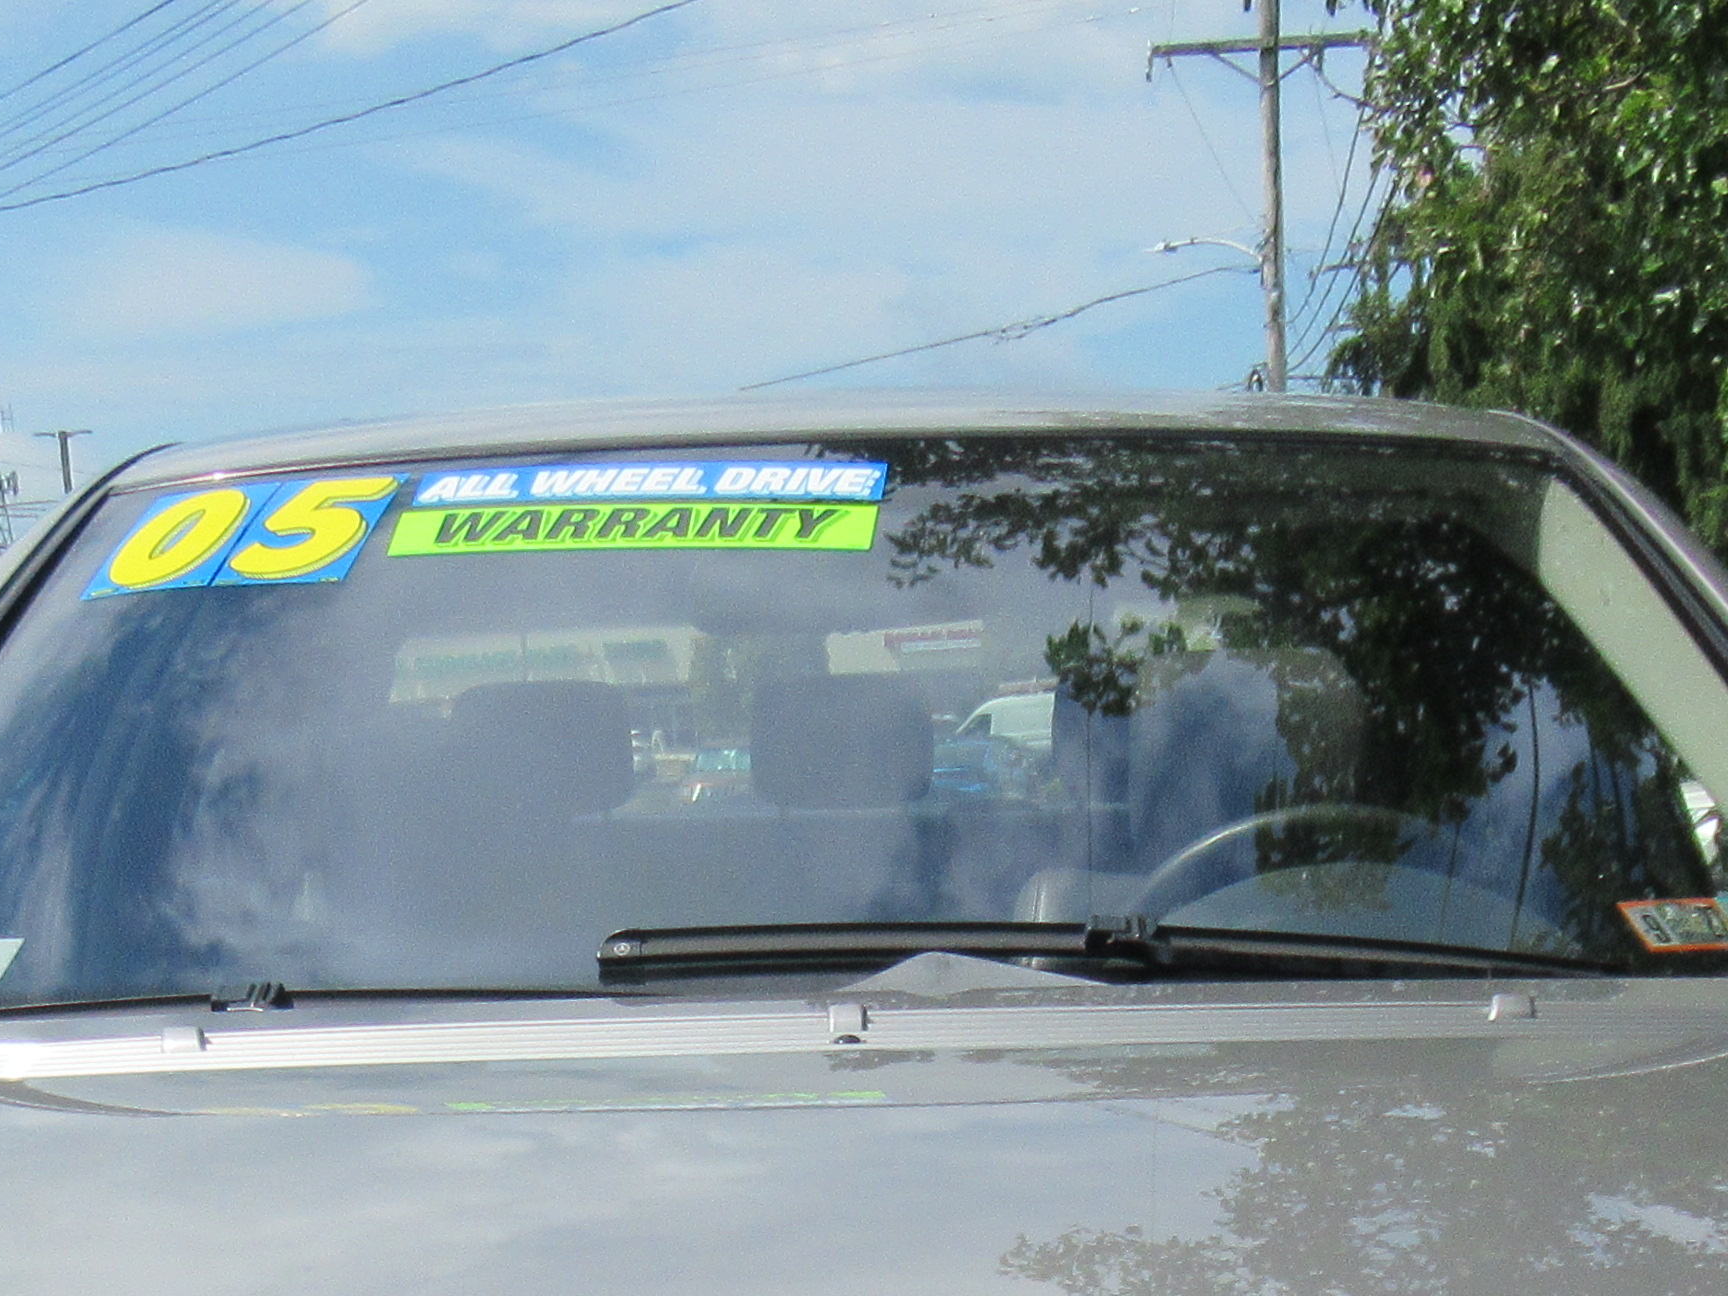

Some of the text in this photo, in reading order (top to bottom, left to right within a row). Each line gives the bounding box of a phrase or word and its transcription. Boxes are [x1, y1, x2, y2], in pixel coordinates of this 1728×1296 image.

[418, 473, 520, 503] ALL
[530, 467, 707, 498] WHEEL
[109, 477, 399, 588] 05
[435, 507, 847, 547] WARRANTY
